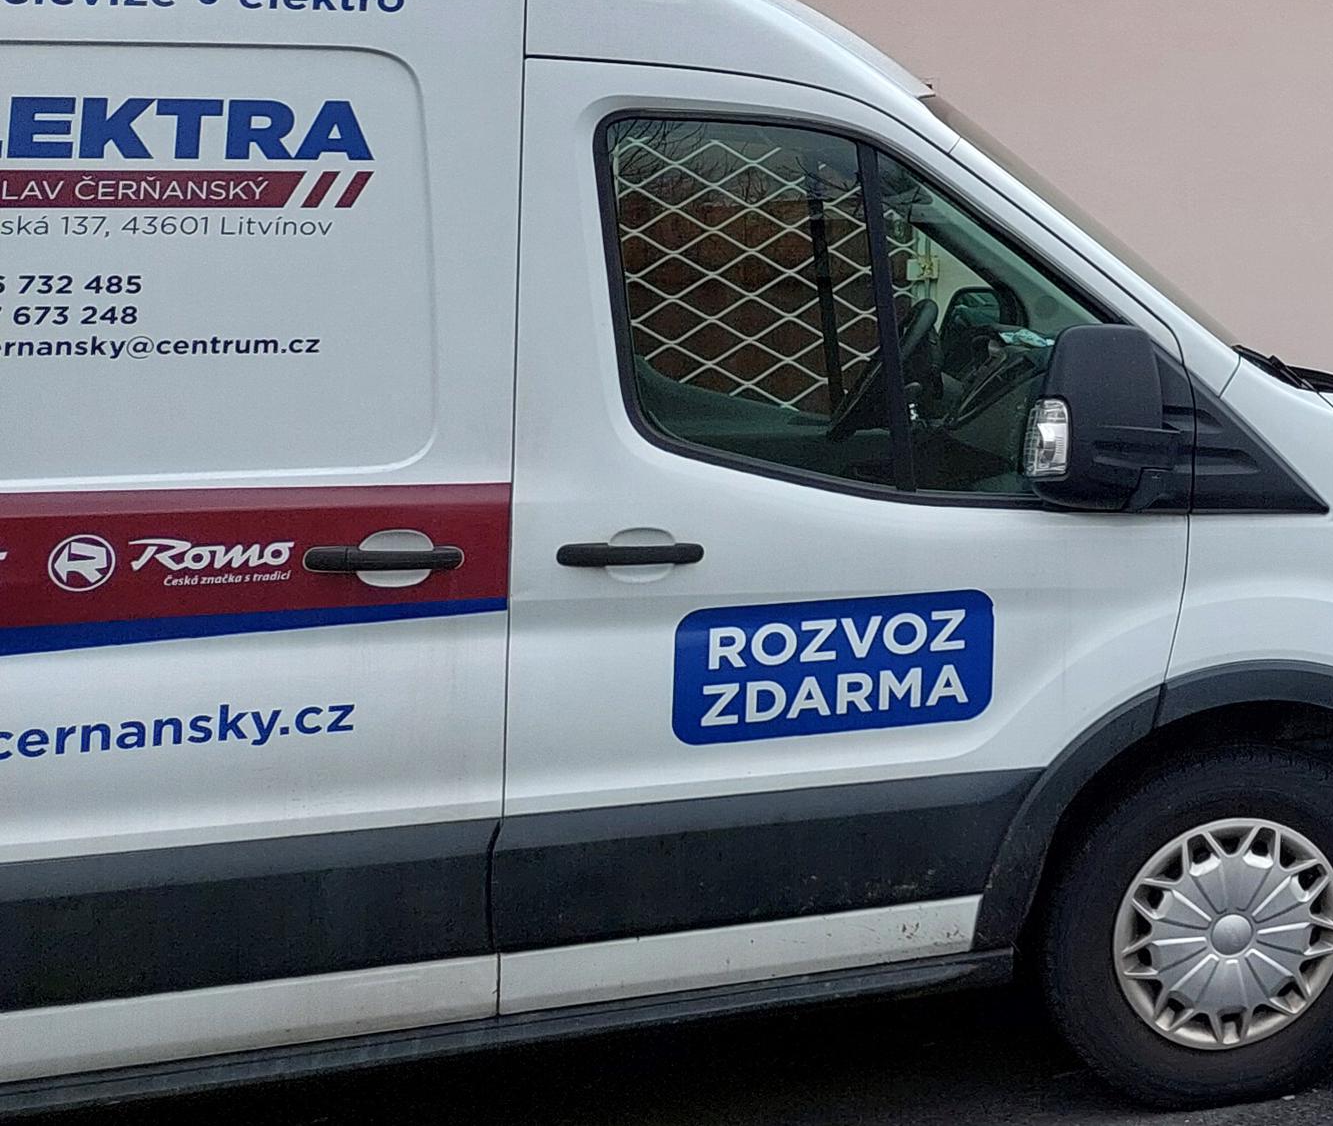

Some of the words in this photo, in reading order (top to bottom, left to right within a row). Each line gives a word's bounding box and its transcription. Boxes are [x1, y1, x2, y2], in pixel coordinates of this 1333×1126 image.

[0, 97, 375, 160] EKTRA
[2, 180, 64, 200] LAV
[75, 176, 269, 200] ČERŇANSKÝ
[1, 215, 50, 236] ská
[61, 216, 110, 238] 137,
[121, 216, 209, 235] 43601
[220, 215, 333, 236] Litvínov
[18, 275, 73, 294] 732
[84, 275, 142, 294] 485
[13, 306, 70, 325] 673
[80, 306, 138, 325] 248
[0, 335, 320, 359] rnansky@centrum.cz
[128, 538, 295, 571] Romo
[163, 574, 199, 586] Česká
[200, 572, 242, 585] značka
[244, 575, 250, 583] s
[707, 609, 966, 670] ROZVOZ
[700, 664, 969, 727] ZDARMA
